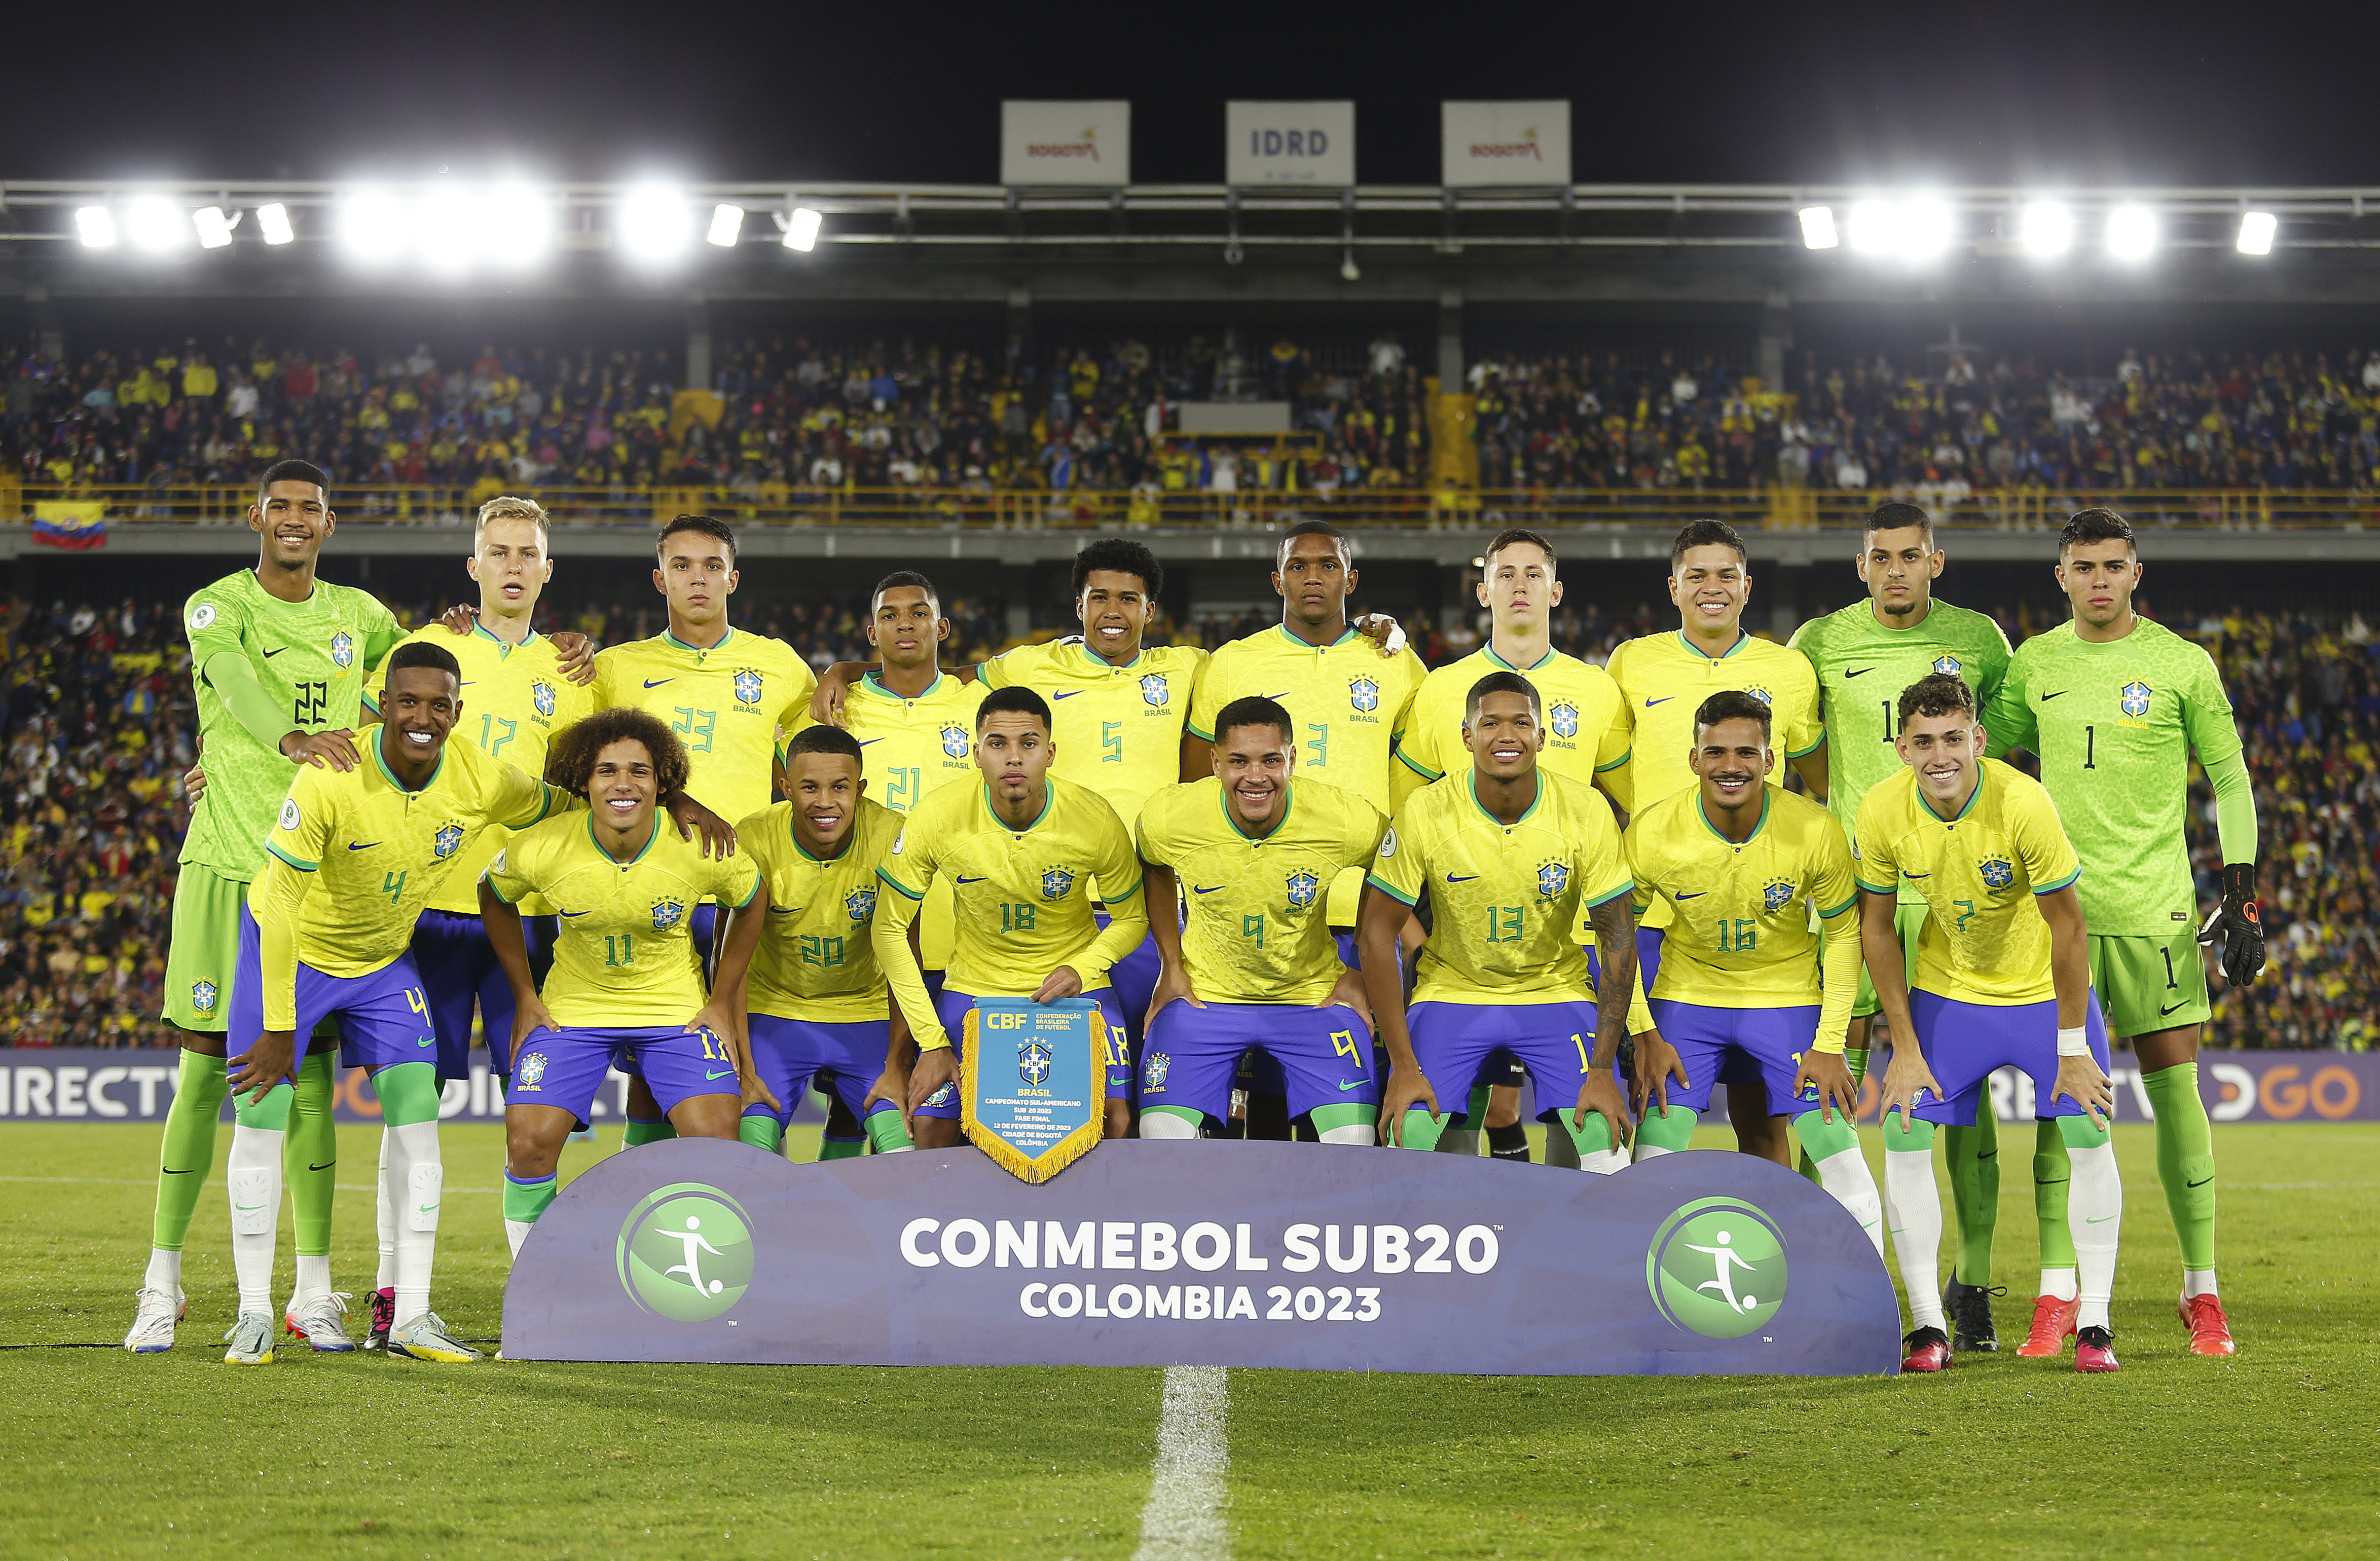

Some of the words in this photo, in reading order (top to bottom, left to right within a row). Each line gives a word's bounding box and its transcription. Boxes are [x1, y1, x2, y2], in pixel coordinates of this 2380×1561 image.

[1250, 131, 1328, 157] IDRD
[294, 682, 327, 724] 22
[733, 705, 762, 715] BRASIL
[1350, 715, 1379, 723] BRASIL
[481, 714, 517, 757] 17
[672, 707, 716, 753] 23
[1882, 700, 1902, 743] 1
[2118, 720, 2149, 728] BRASIL
[1103, 721, 1122, 762] 5
[1307, 724, 1327, 767] 3
[1550, 740, 1577, 750] BRASIL
[2084, 726, 2095, 769] 1
[943, 761, 970, 769] BRASIL
[887, 767, 921, 811] 21
[383, 870, 407, 904] 4
[1988, 882, 2018, 895] BRASIL
[1000, 903, 1035, 934] 18
[1243, 914, 1263, 949] 9
[1487, 906, 1523, 943] 13
[1953, 900, 1975, 932] 7
[605, 934, 634, 966] 11
[800, 935, 844, 967] 20
[1718, 919, 1755, 952] 16
[2160, 947, 2178, 990] 1
[404, 986, 432, 1028] 4
[987, 1013, 1028, 1029] CBF
[1329, 1029, 1362, 1068] 9
[1017, 1088, 1052, 1097] BRASIL
[899, 1217, 1269, 1271] CONMEBOL
[1019, 1282, 1258, 1320] COLOMBIA
[1265, 1285, 1382, 1322] 2023
